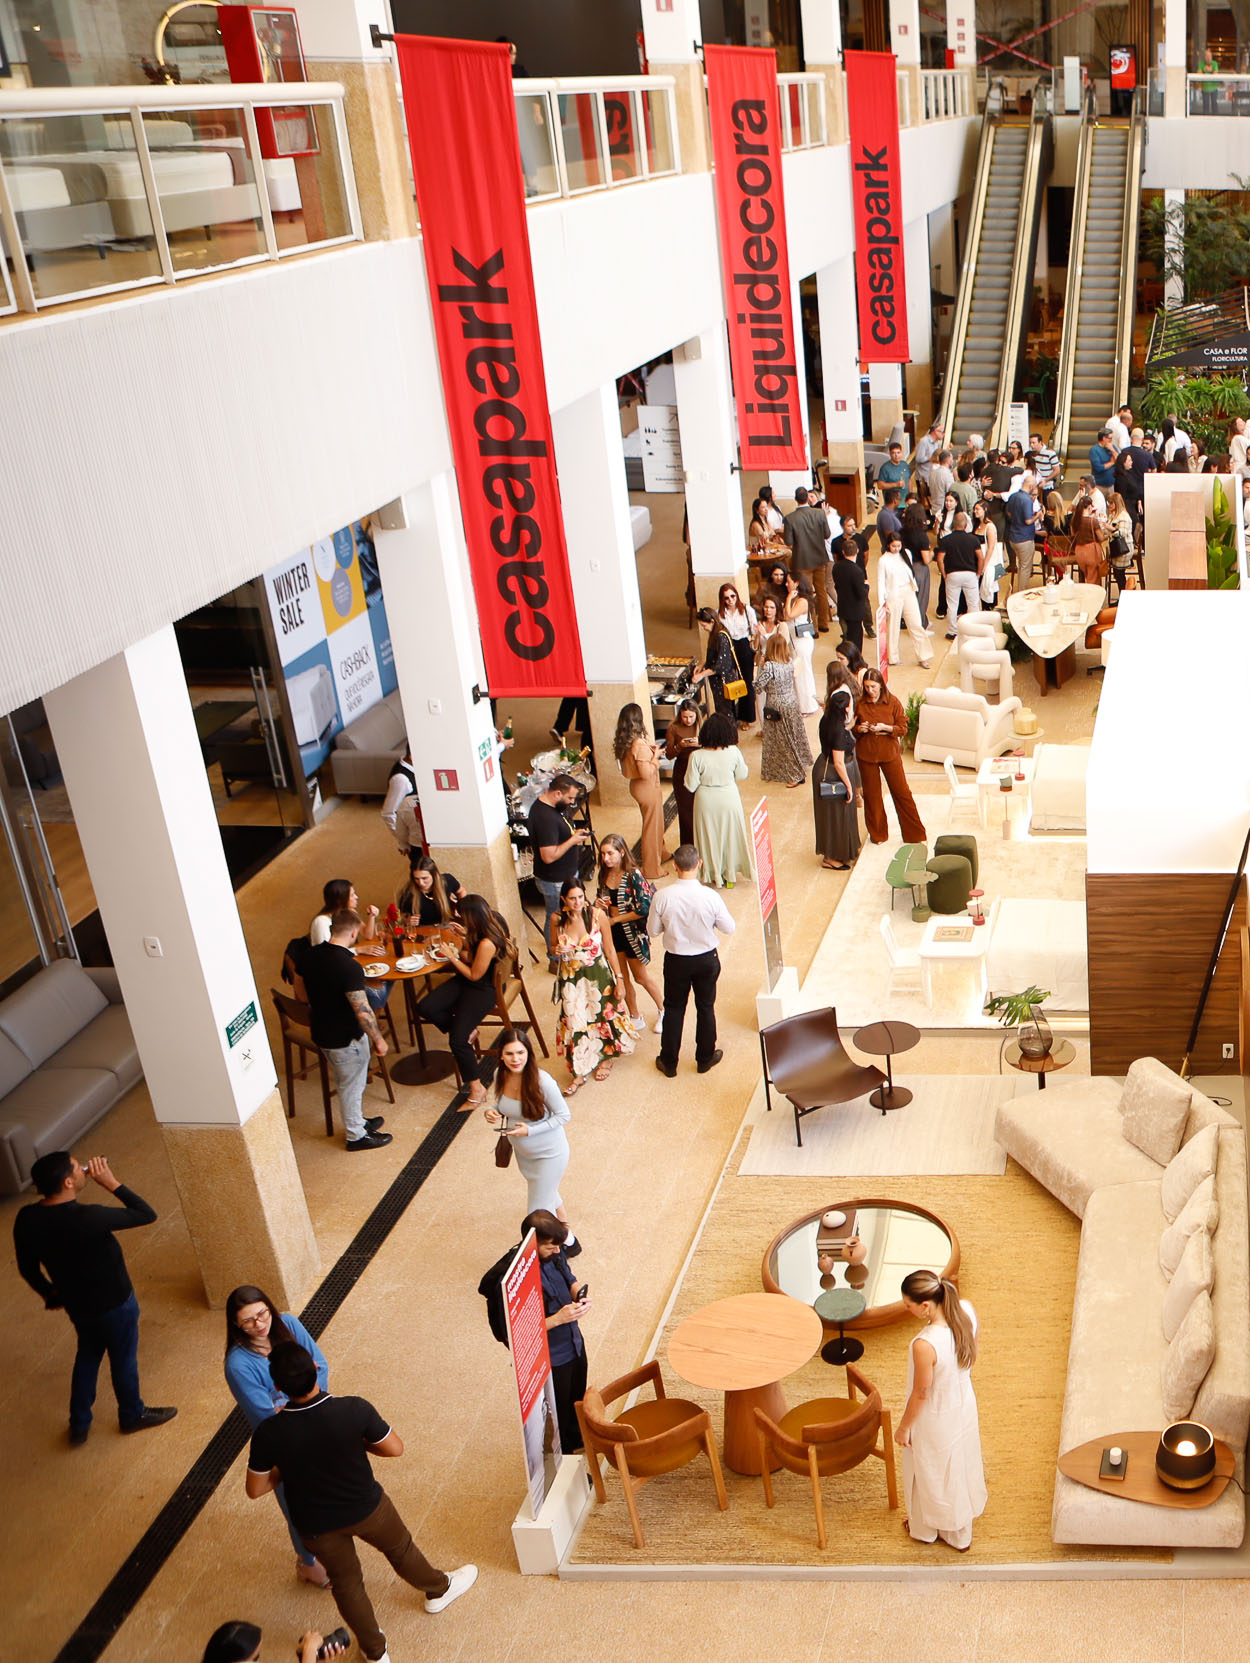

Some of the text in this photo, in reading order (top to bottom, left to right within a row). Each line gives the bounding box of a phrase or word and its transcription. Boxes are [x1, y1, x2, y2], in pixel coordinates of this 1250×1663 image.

[731, 99, 796, 447] Liquidecora
[855, 144, 899, 346] casapark
[1203, 347, 1224, 356] CASA
[1230, 347, 1248, 355] FLOR
[438, 246, 556, 662] casapark
[273, 562, 311, 606] WINTER
[279, 598, 305, 636] SALE
